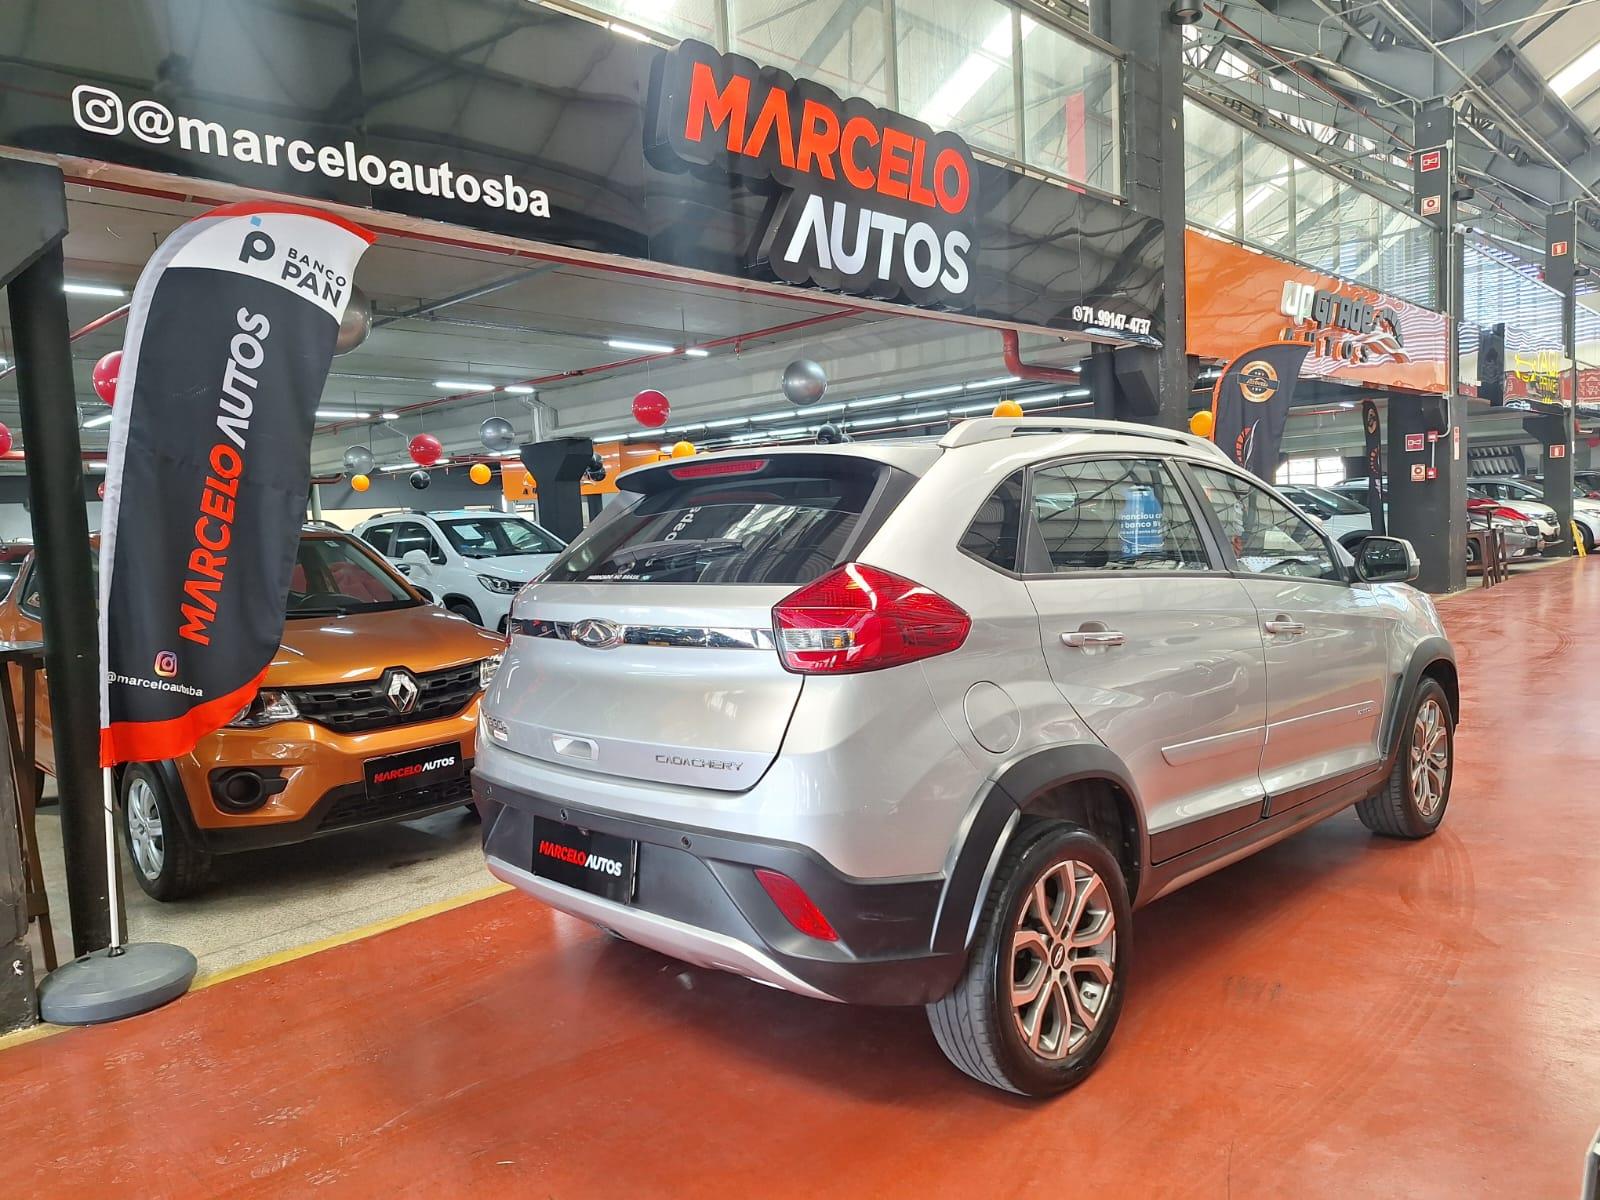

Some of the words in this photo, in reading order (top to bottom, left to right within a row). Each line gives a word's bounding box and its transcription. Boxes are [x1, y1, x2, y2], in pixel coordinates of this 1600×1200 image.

[127, 100, 551, 218] @marceloautosba
[685, 62, 970, 214] MARCELO
[288, 247, 347, 287] BANCO
[784, 194, 970, 294] AUTOS
[281, 260, 342, 307] PAN
[179, 443, 243, 646] MARCELO
[216, 306, 270, 451] AUTOS
[422, 756, 456, 772] AUTOS
[539, 840, 587, 867] MARCELO
[585, 853, 623, 877] AUTOS
